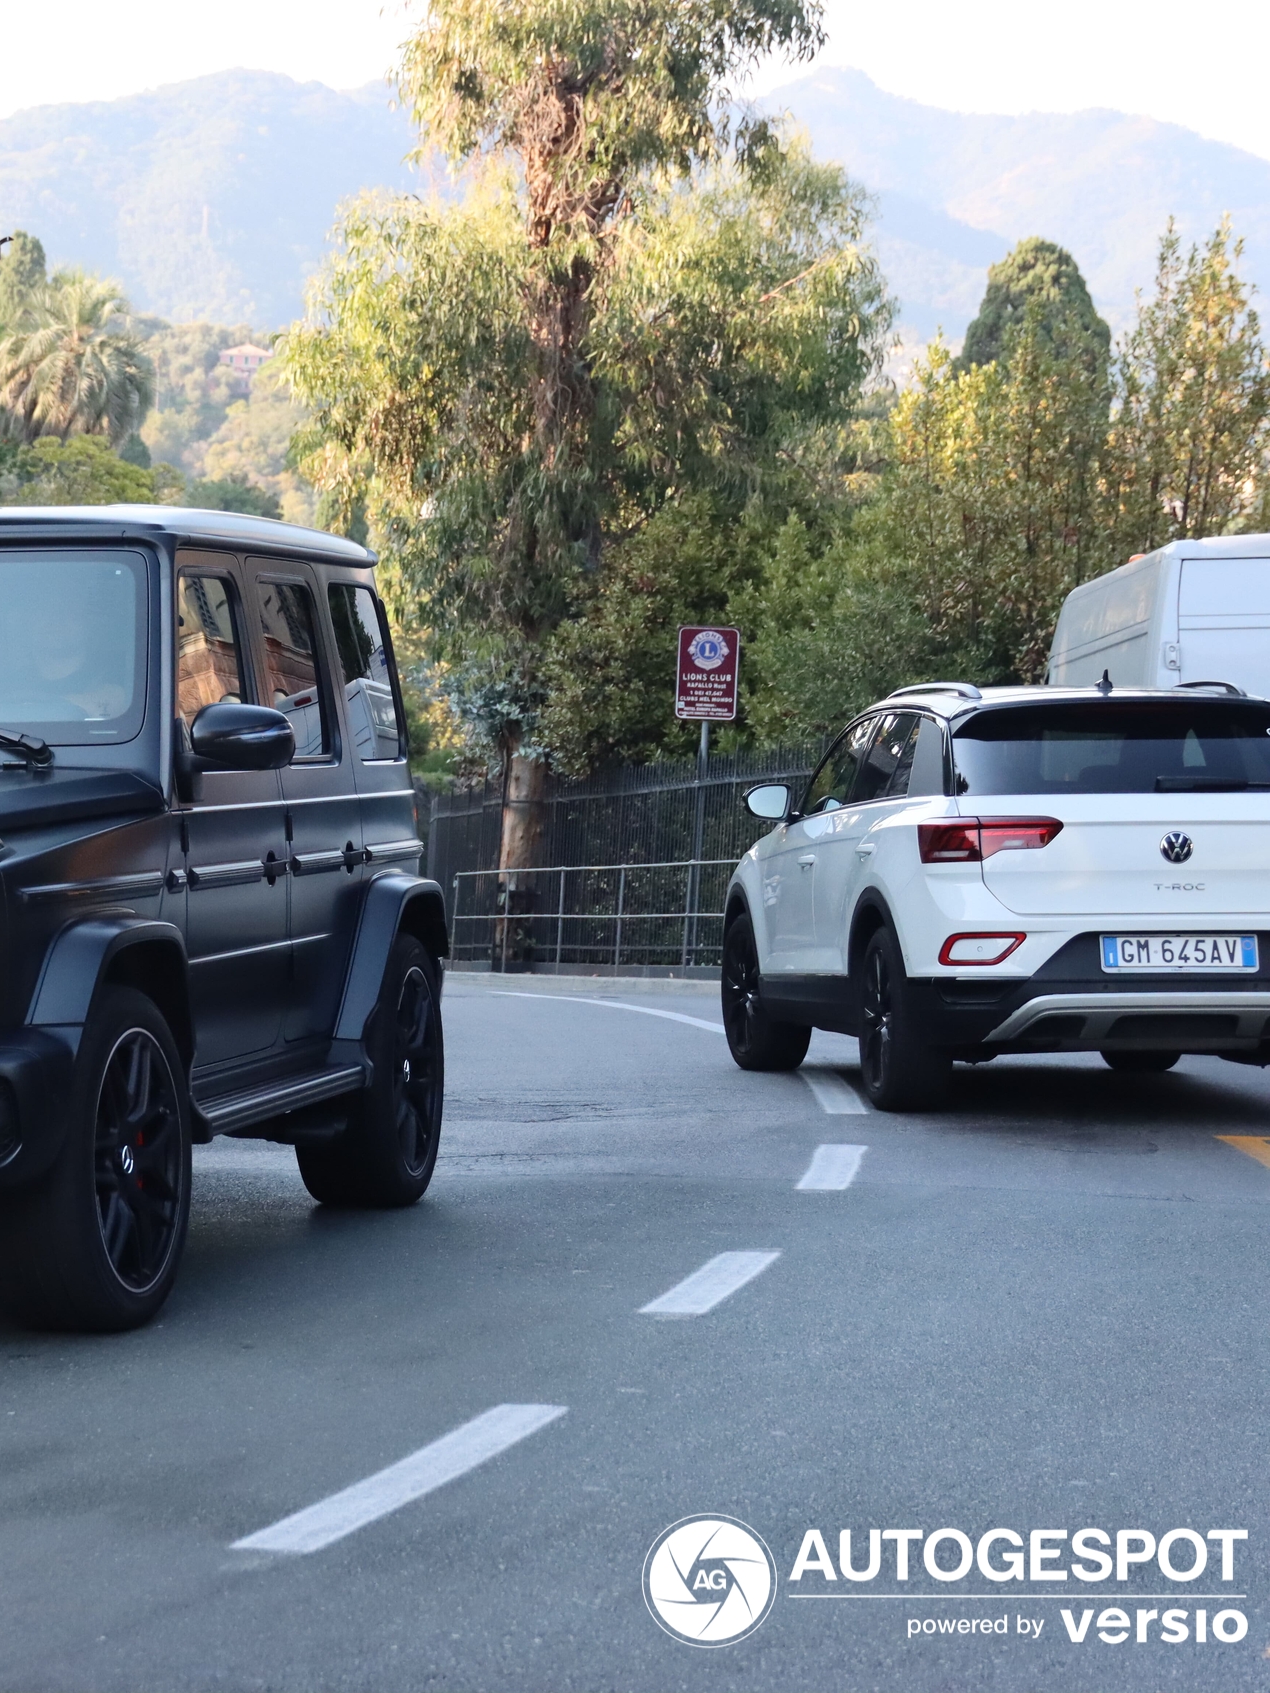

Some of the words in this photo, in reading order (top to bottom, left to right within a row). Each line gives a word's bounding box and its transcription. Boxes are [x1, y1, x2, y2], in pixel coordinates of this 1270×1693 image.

[697, 632, 721, 641] LIONS
[704, 643, 715, 657] L
[682, 673, 707, 681] LIONS
[710, 674, 732, 682] CLUB
[1154, 883, 1205, 891] T-ROC
[1121, 939, 1151, 964] GM
[1161, 939, 1237, 964] 645AV
